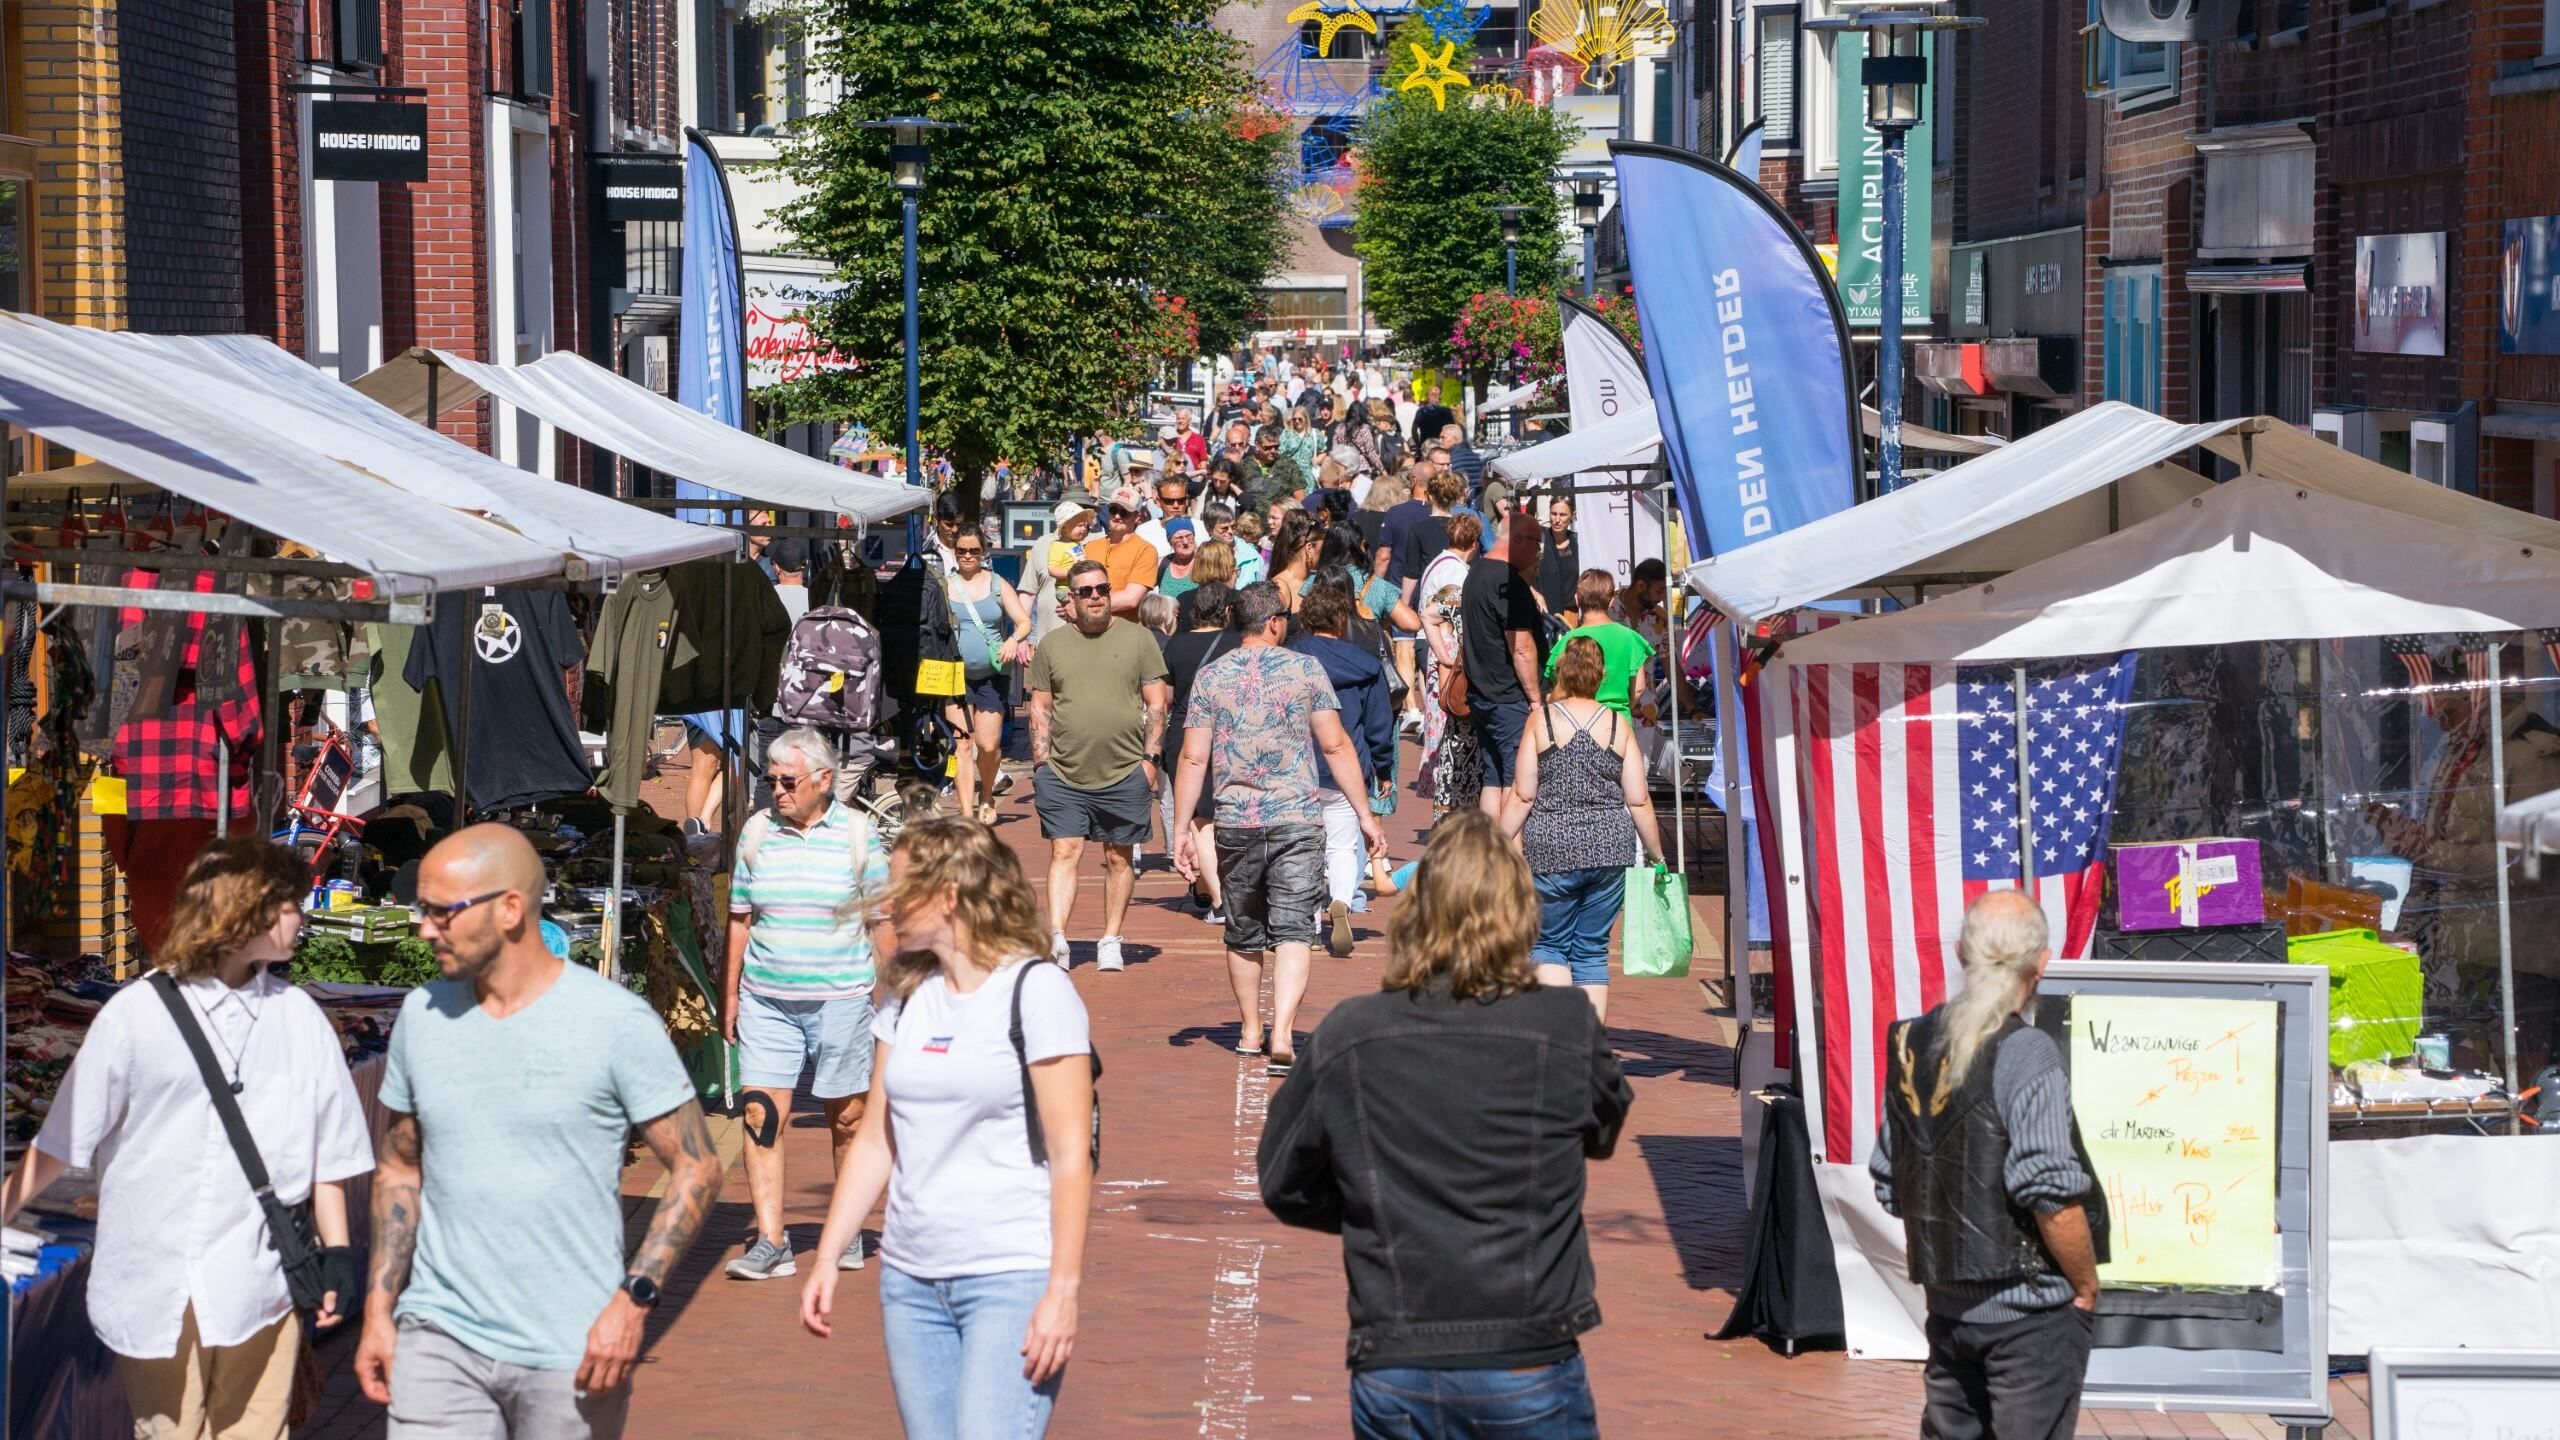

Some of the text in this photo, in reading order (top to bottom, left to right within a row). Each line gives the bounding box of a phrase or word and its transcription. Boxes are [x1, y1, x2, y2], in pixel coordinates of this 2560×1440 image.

[320, 133, 366, 149] HOUSE
[374, 134, 420, 150] INDIGO
[607, 187, 639, 198] HOUSE
[645, 187, 678, 199] INDIGO
